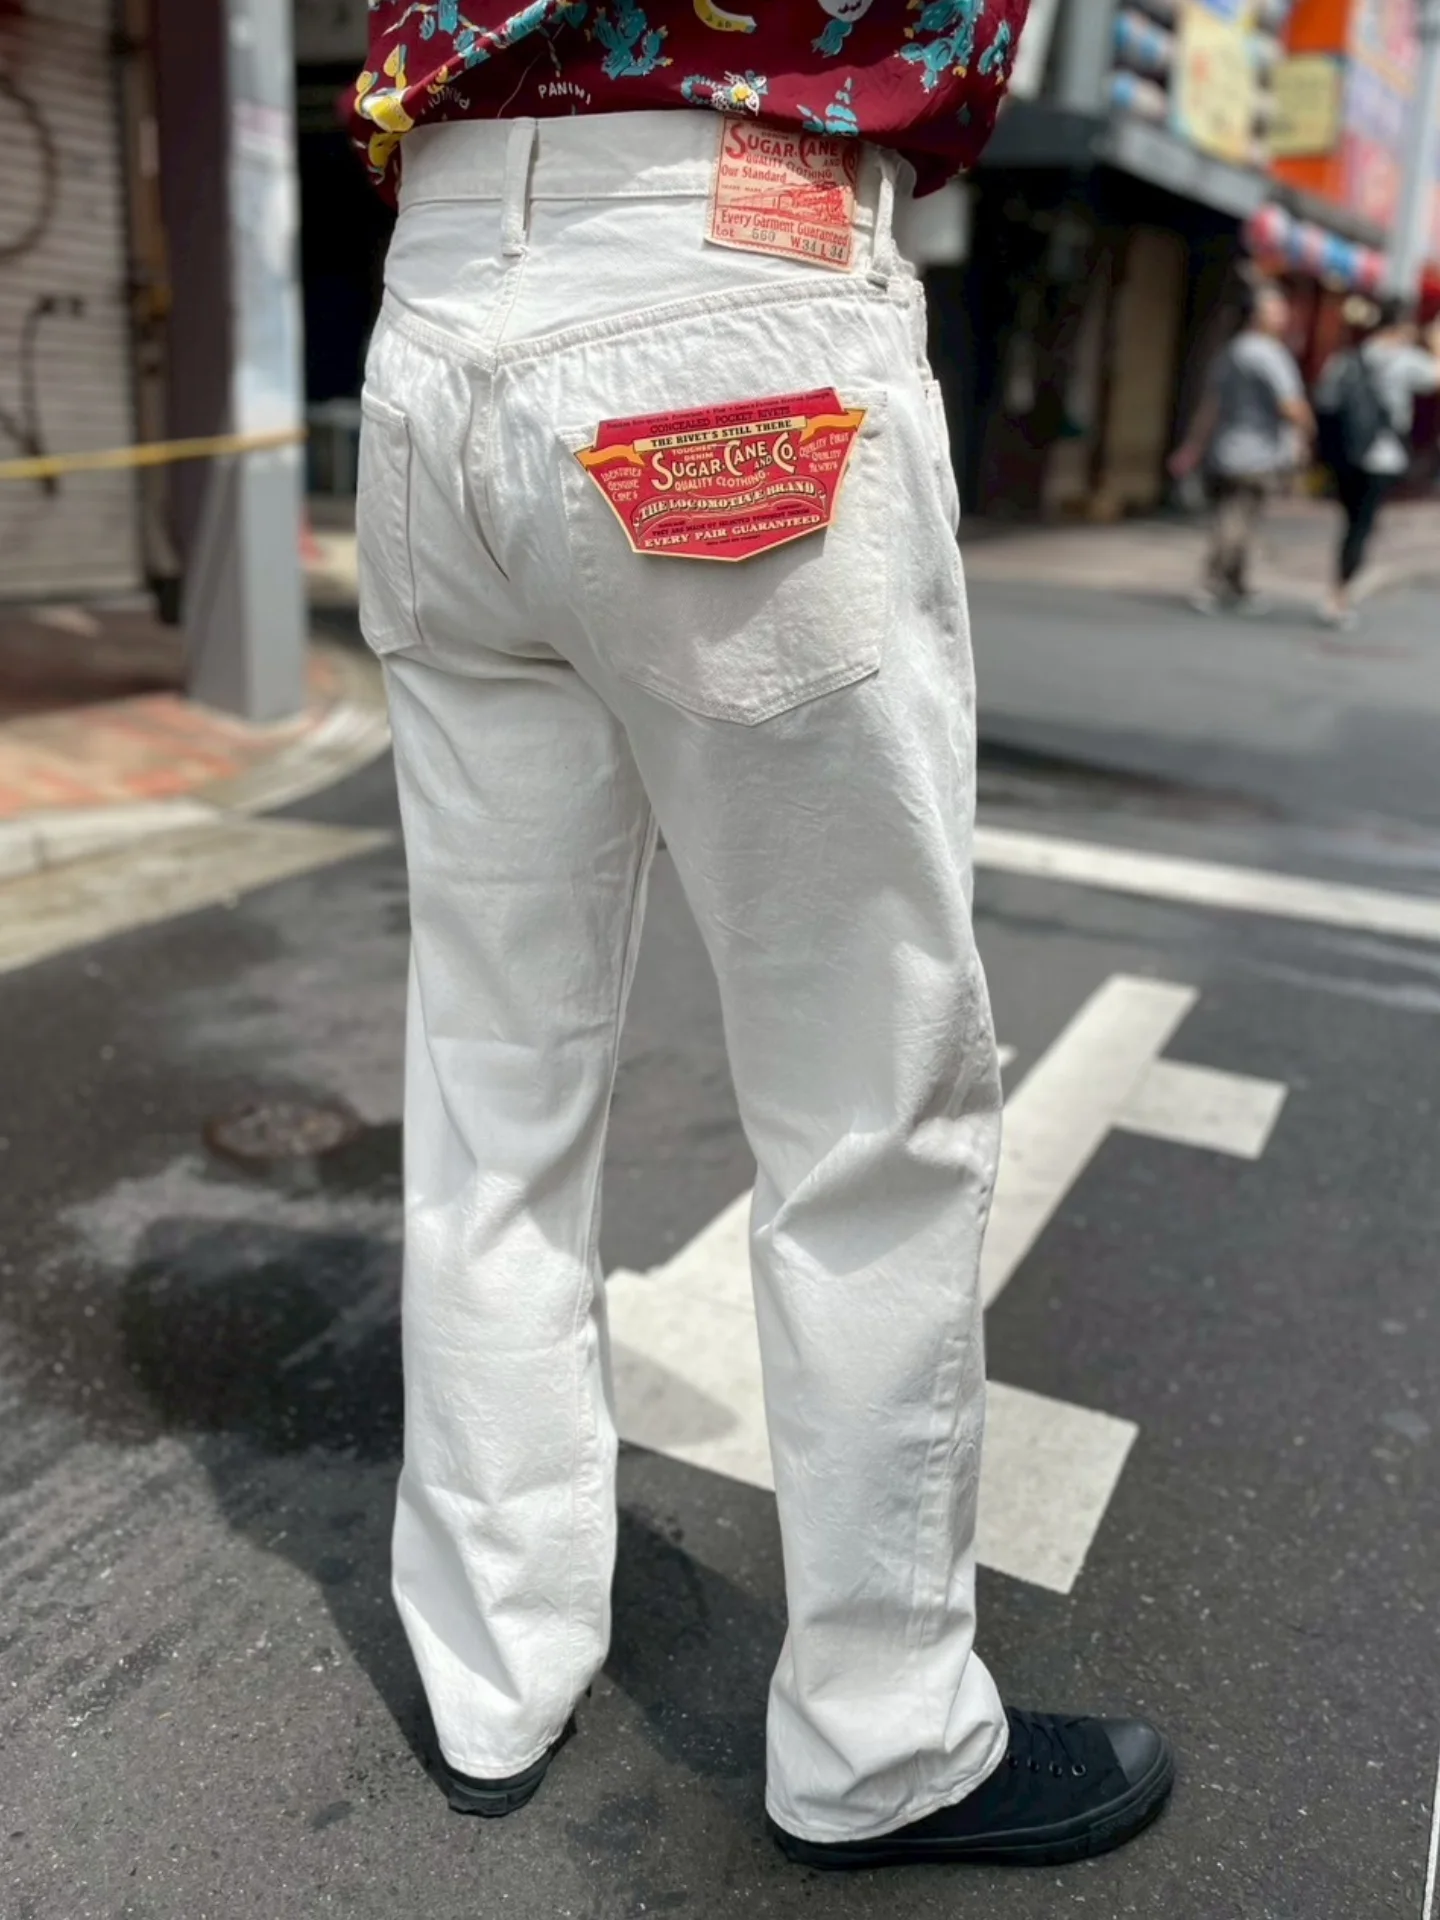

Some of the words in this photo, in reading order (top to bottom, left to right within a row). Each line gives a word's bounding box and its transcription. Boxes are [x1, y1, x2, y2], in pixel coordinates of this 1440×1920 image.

[799, 135, 839, 169] CANE
[721, 164, 739, 177] Our
[742, 166, 787, 184] Standard
[746, 154, 784, 168] QUALITY
[785, 160, 833, 180] CLOTHING
[721, 209, 751, 228] Every
[753, 214, 795, 232] Garment
[797, 223, 849, 247] Guaranteed
[790, 236, 799, 248] W
[802, 238, 817, 252] 34
[830, 246, 844, 259] 34
[649, 418, 711, 434] CONCEALED
[715, 411, 753, 425] POCKET
[757, 406, 791, 418] RIVETS
[650, 437, 673, 448] THE
[676, 430, 718, 444] RIVET'S
[721, 425, 752, 437] STILL
[755, 419, 792, 432] THERE
[723, 439, 768, 476] CANE
[754, 455, 773, 470] AND
[674, 476, 713, 492] QUALITY
[639, 500, 668, 520] THE
[668, 489, 764, 510] LOCOMOTIVE
[766, 480, 815, 496] BRAND
[644, 533, 690, 548] EVERY
[694, 528, 727, 540] PAIR
[731, 514, 821, 535] GUARANTEED
